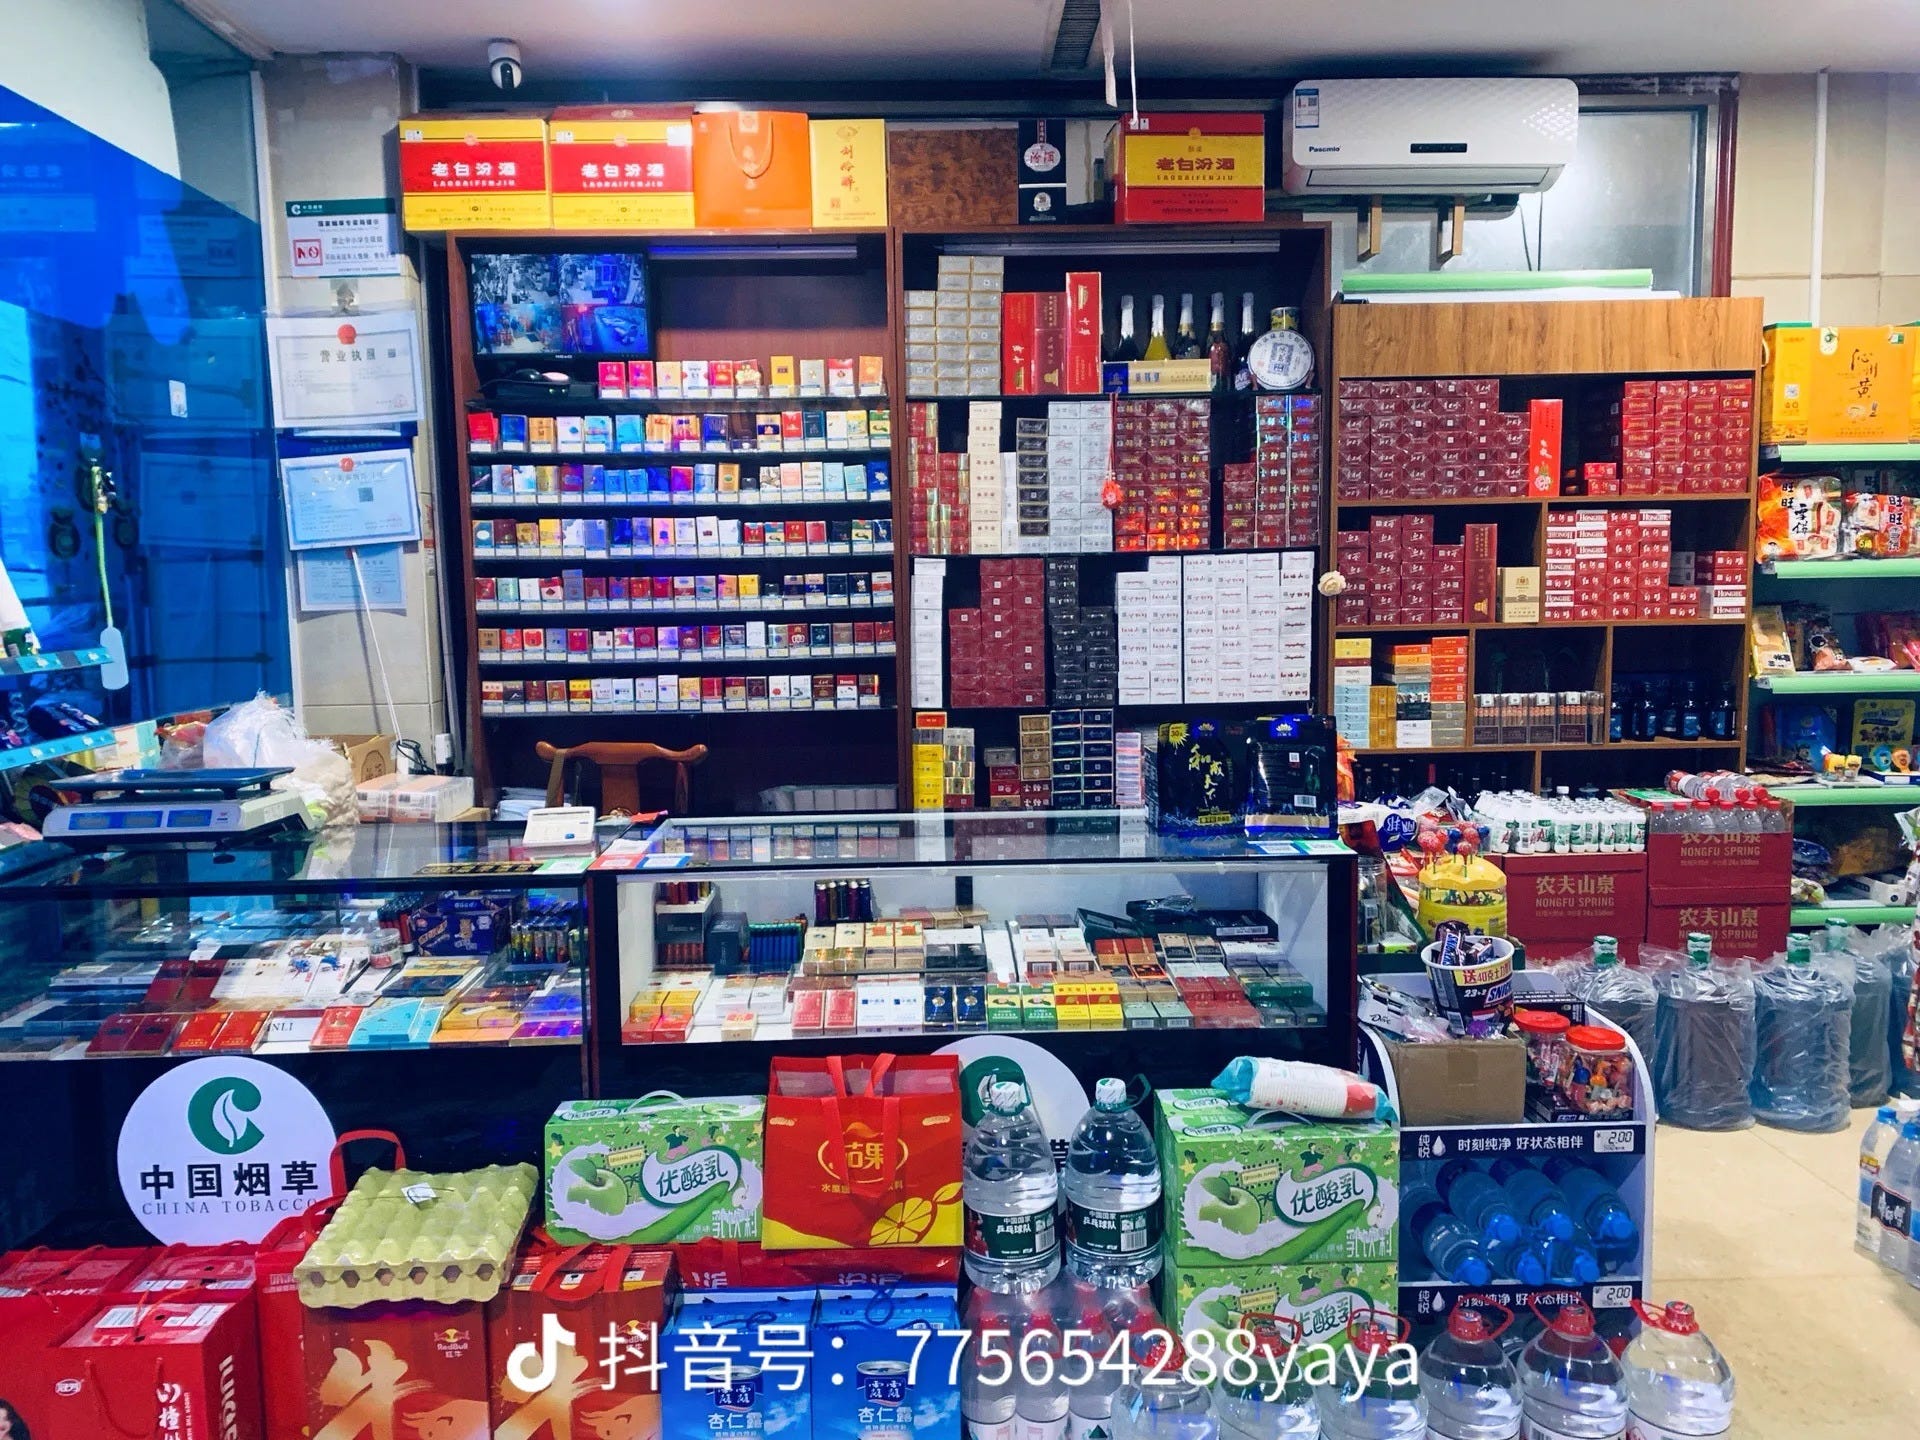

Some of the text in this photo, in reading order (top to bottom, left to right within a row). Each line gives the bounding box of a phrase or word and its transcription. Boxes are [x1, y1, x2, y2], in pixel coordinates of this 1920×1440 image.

[431, 162, 516, 177] 老白汾酒
[581, 163, 665, 177] 老白汾酒
[1156, 158, 1235, 171] 老白汾酒
[320, 347, 376, 363] 营业执照
[1781, 481, 1794, 509] 旺旺
[1889, 494, 1903, 525] 旺旺
[1681, 846, 1760, 857] NONGFU SPRING
[1535, 874, 1615, 895] 农夫山泉
[1536, 897, 1615, 908] NONGFU SPRING
[1680, 907, 1759, 927] 农夫山泉
[1722, 929, 1758, 939] SPRING
[1418, 1134, 1430, 1158] 纯悦
[1458, 1135, 1584, 1151] 时刻纯净 好状态相伴
[1608, 1131, 1633, 1146] 2.00
[140, 1160, 318, 1200] 中国烟草
[656, 1153, 729, 1198] 优酸乳
[1290, 1171, 1364, 1217] 优酸乳
[142, 1197, 320, 1216] CHINA TOBACCO
[1004, 1216, 1031, 1225] 中国国家
[1089, 1210, 1117, 1220] 中国国家
[996, 1224, 1032, 1235] 乒乓球队
[1083, 1218, 1117, 1230] 乒乓球队
[1418, 1290, 1430, 1314] 纯悦
[1606, 1287, 1631, 1301] 2.00
[1290, 1295, 1357, 1340] 优酸乳
[707, 1413, 764, 1431] 杏仁露
[858, 1407, 914, 1424] 杏仁露
